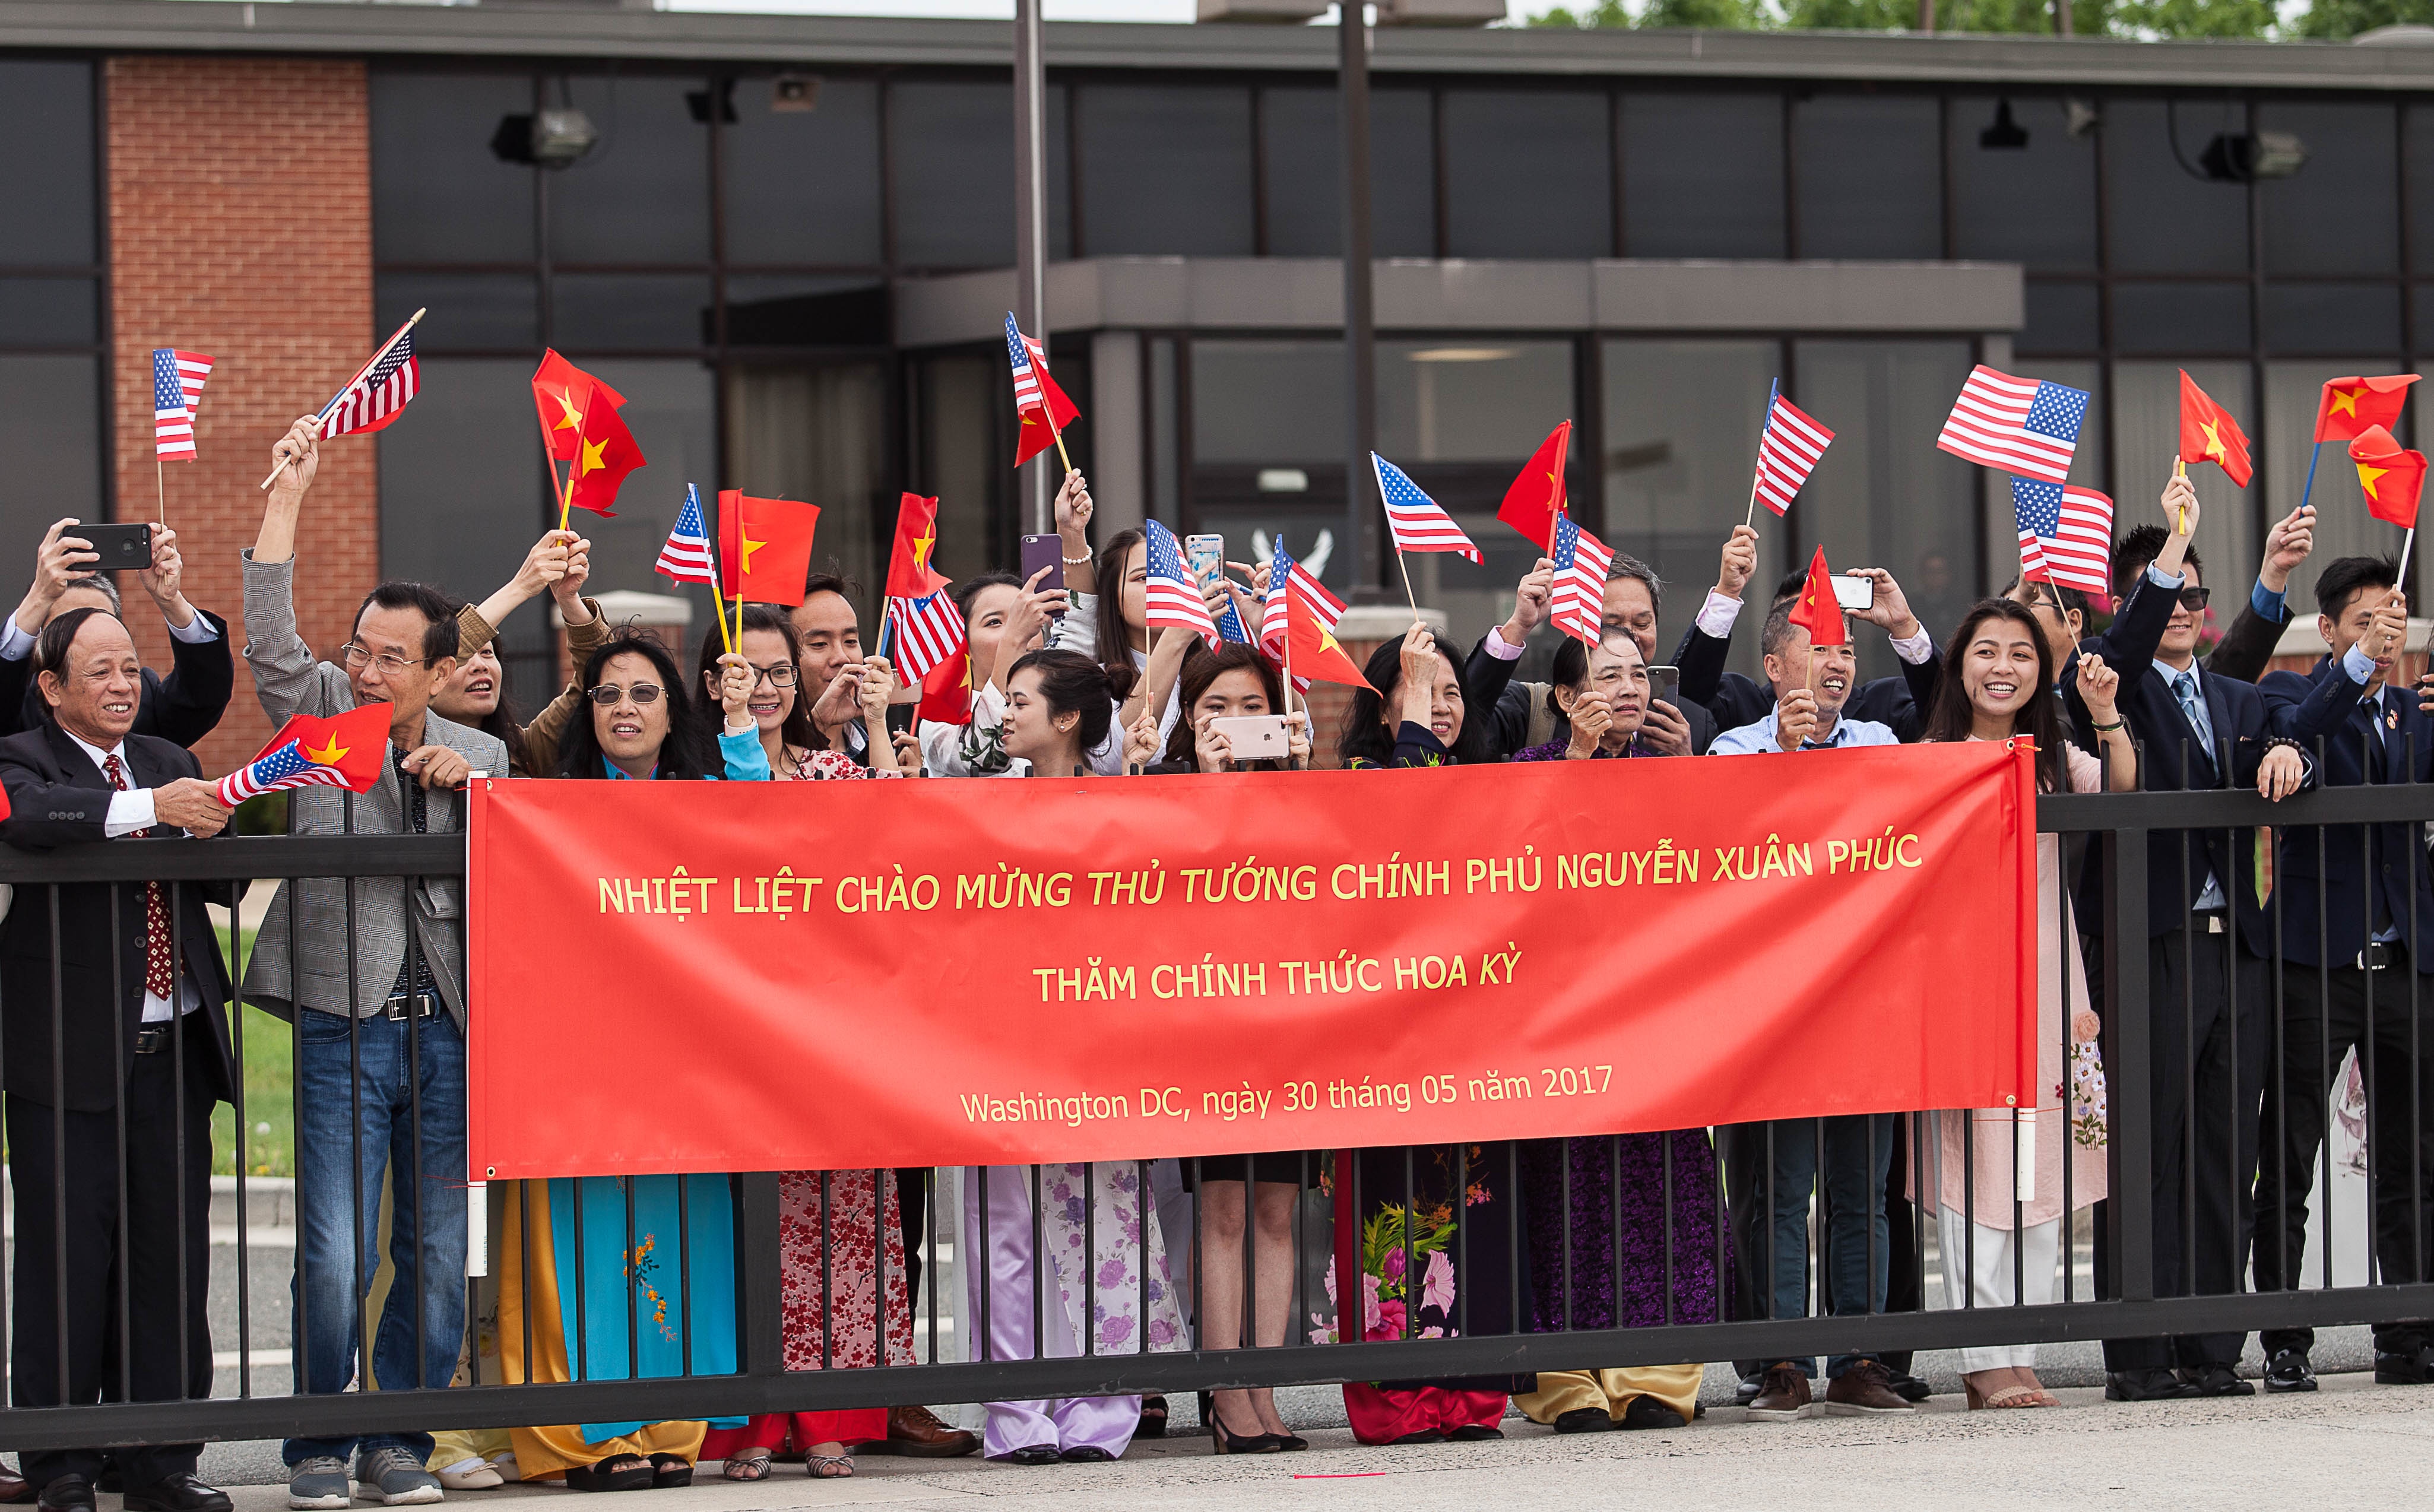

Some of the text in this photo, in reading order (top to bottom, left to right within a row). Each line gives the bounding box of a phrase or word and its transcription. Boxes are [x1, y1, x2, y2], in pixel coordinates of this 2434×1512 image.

[597, 825, 1923, 923] NHIỆT LIỆT CHÀO MỪNG THỦ TƯỚNG CHÍNH PHỦ NGUYỄN XUÂN PHÚC
[1032, 940, 1523, 1003] THĂM CHÍNH THỨC HOA KỲ
[959, 1064, 1613, 1128] Washington DC, ngày 30 tháng 05 năm 2017
